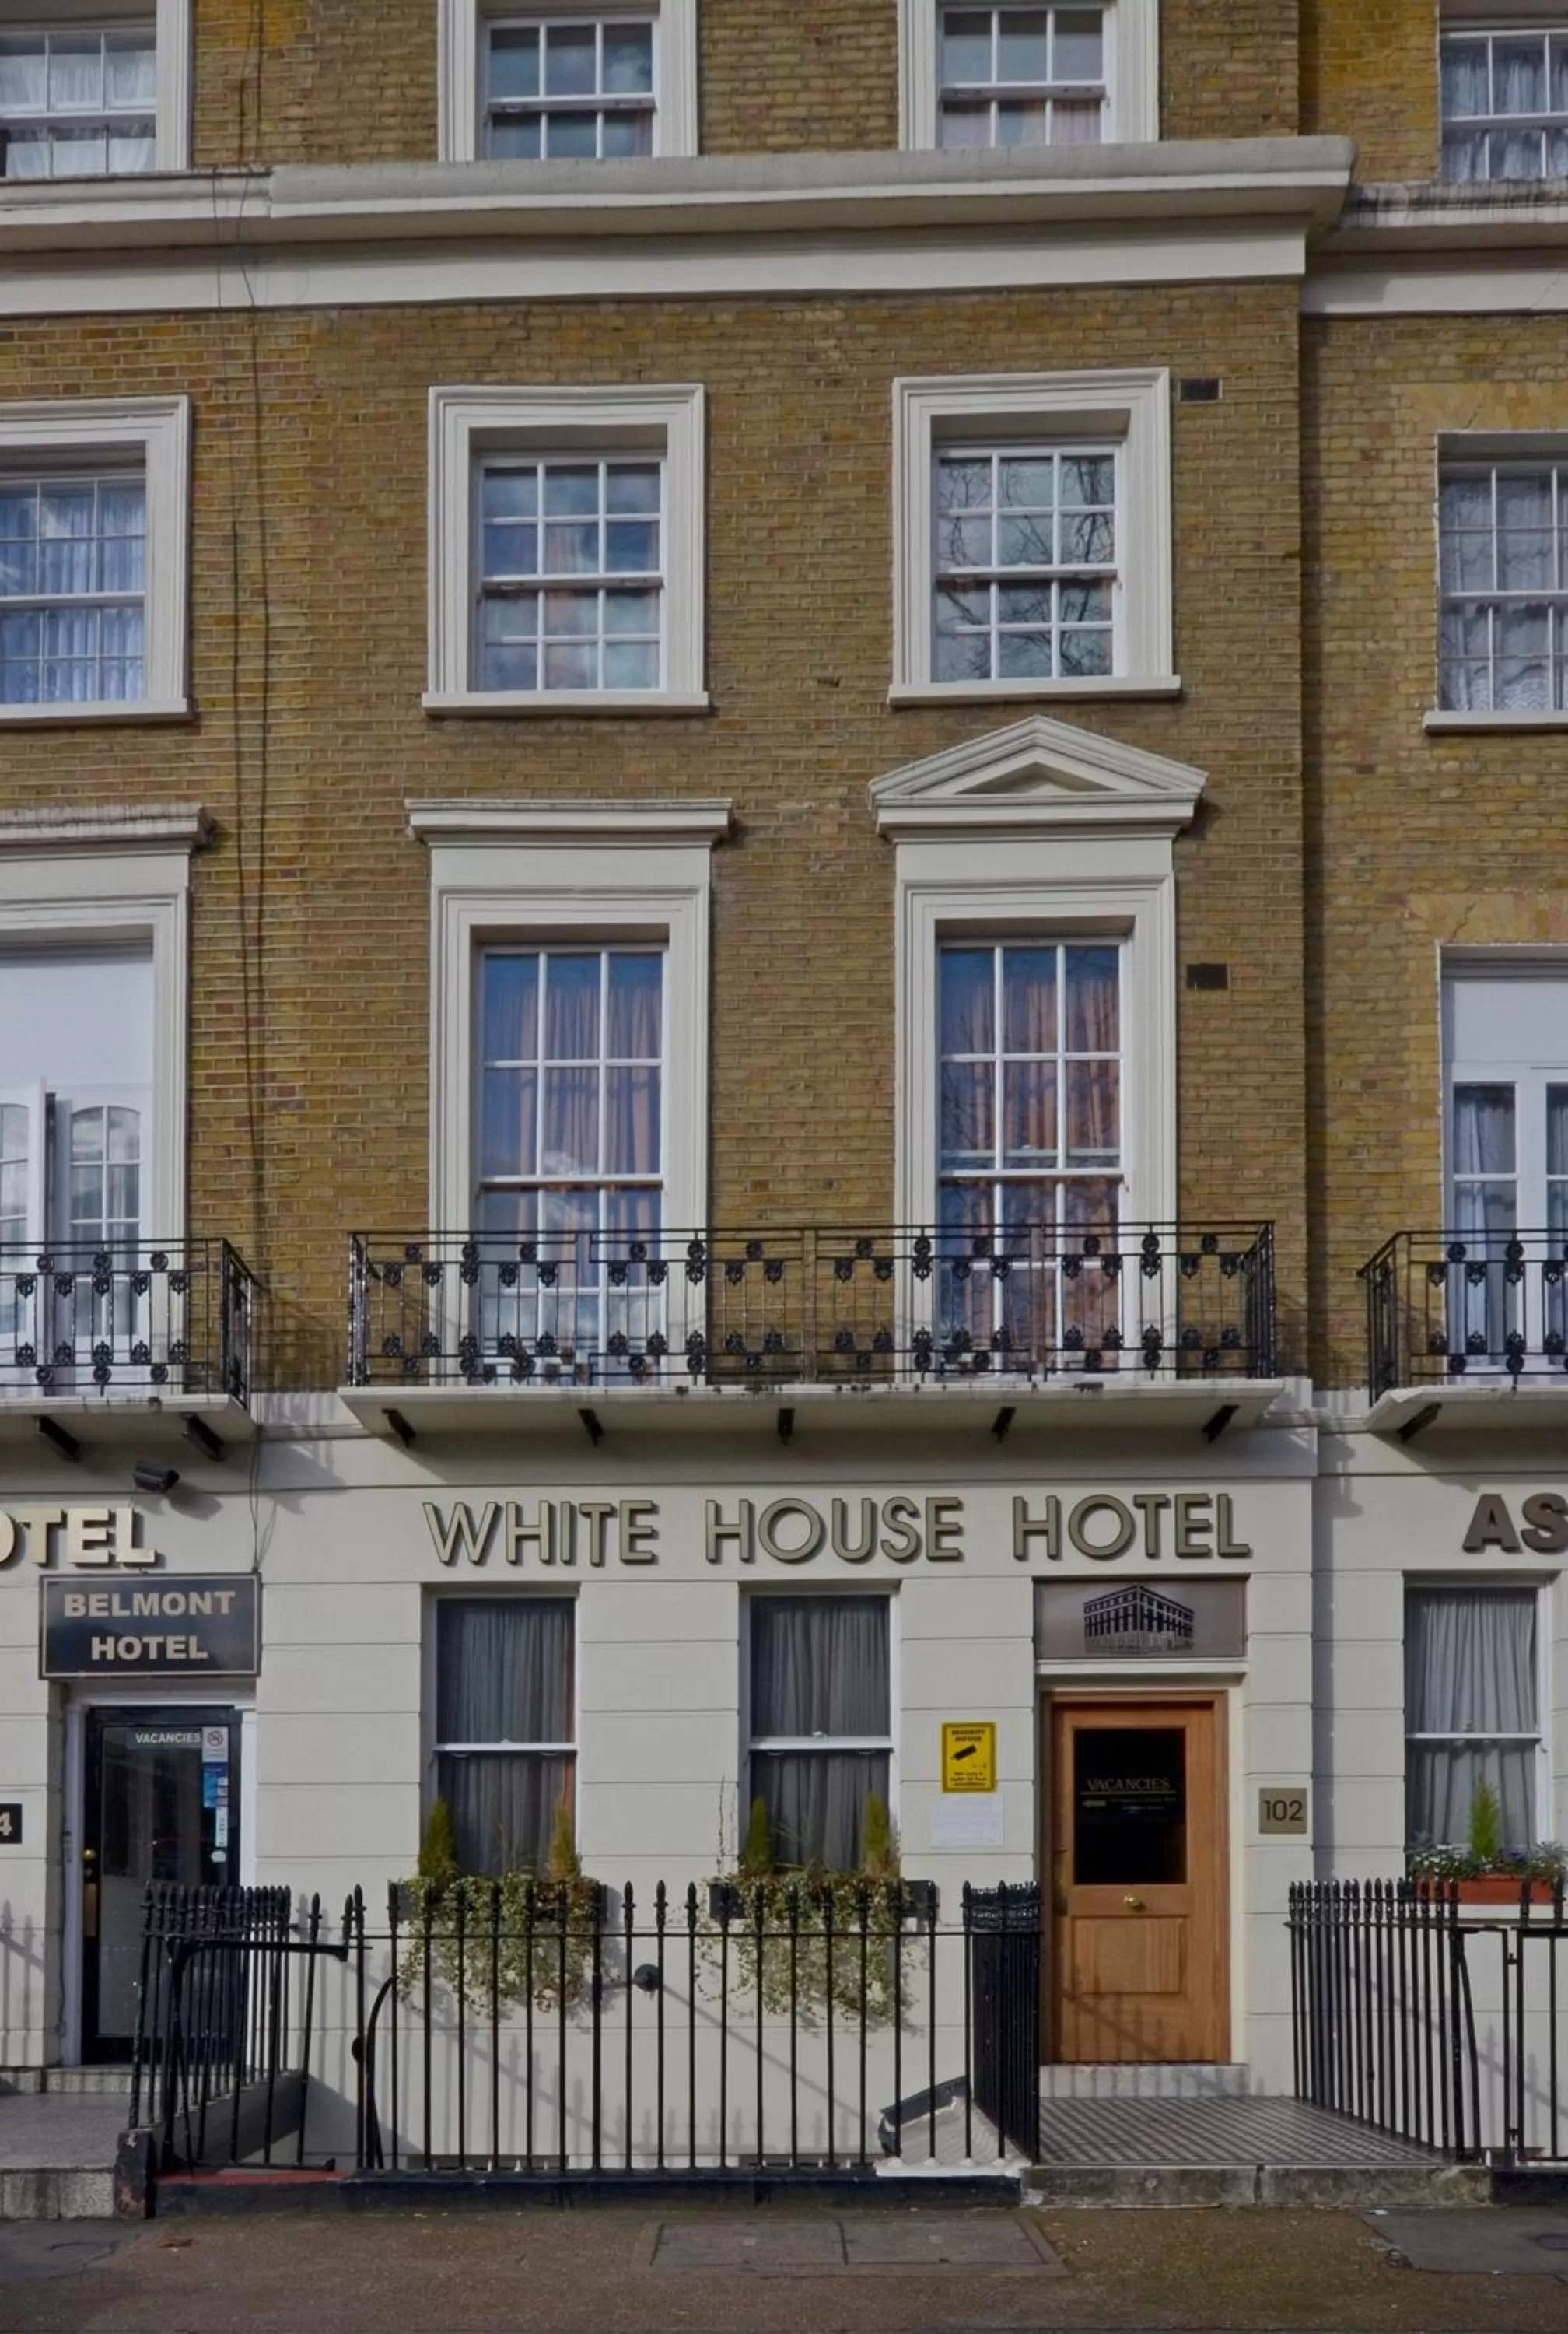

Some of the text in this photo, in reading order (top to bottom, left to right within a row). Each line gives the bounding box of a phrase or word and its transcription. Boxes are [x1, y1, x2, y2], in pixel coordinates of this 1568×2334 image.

[422, 1493, 1252, 1565] WHITE HOUSE HOTEL
[1461, 1492, 1568, 1554] AS
[63, 1590, 236, 1618] BELMONT
[90, 1635, 208, 1661] HOTEL
[135, 1732, 201, 1743] VACANCIES
[1087, 1776, 1171, 1791] VACANCIES
[1263, 1799, 1303, 1822] 102
